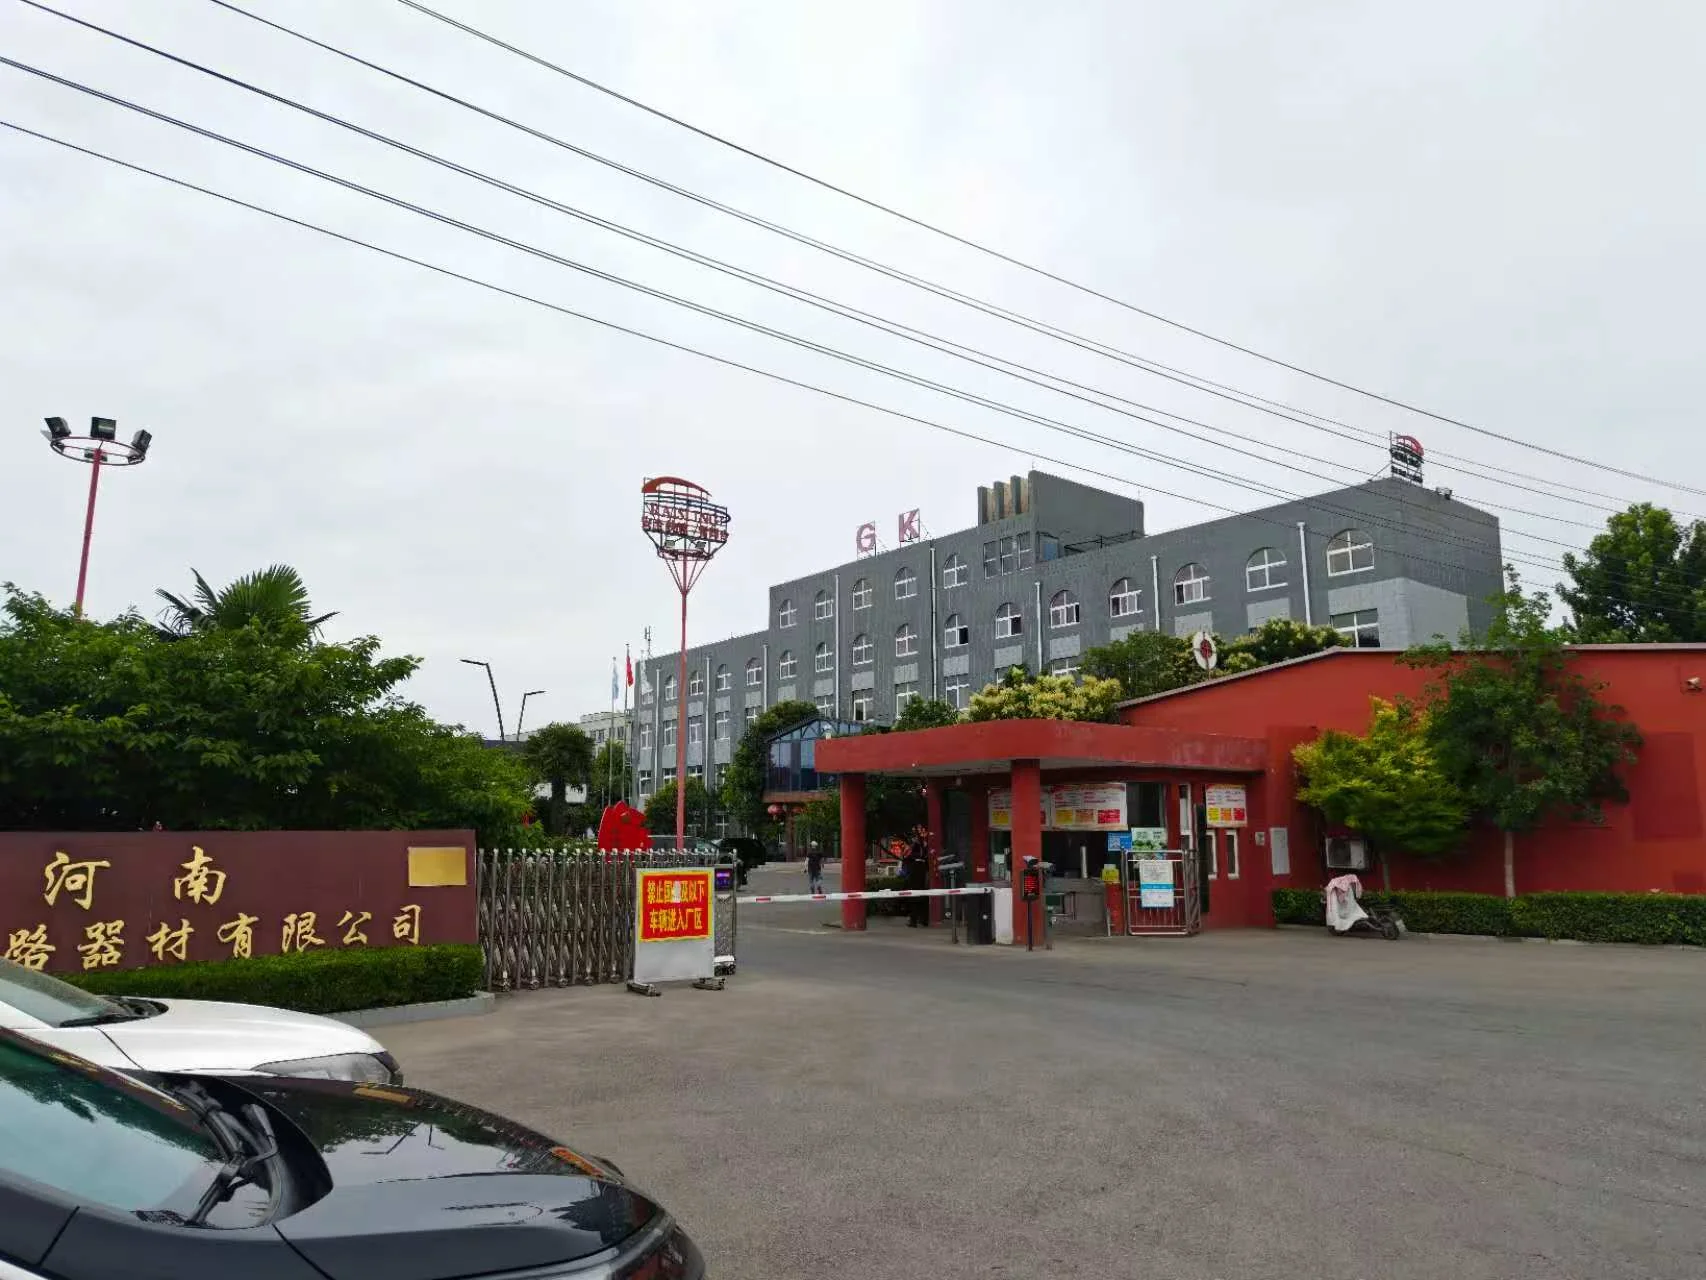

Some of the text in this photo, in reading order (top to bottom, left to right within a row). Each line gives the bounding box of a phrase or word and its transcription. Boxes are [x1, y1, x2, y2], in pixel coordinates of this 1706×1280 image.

[43, 846, 227, 910] 河南
[647, 880, 705, 904] 禁止国及以下
[4, 904, 423, 971] 路器材有限公司
[649, 908, 704, 933] 车辆进入厂区
